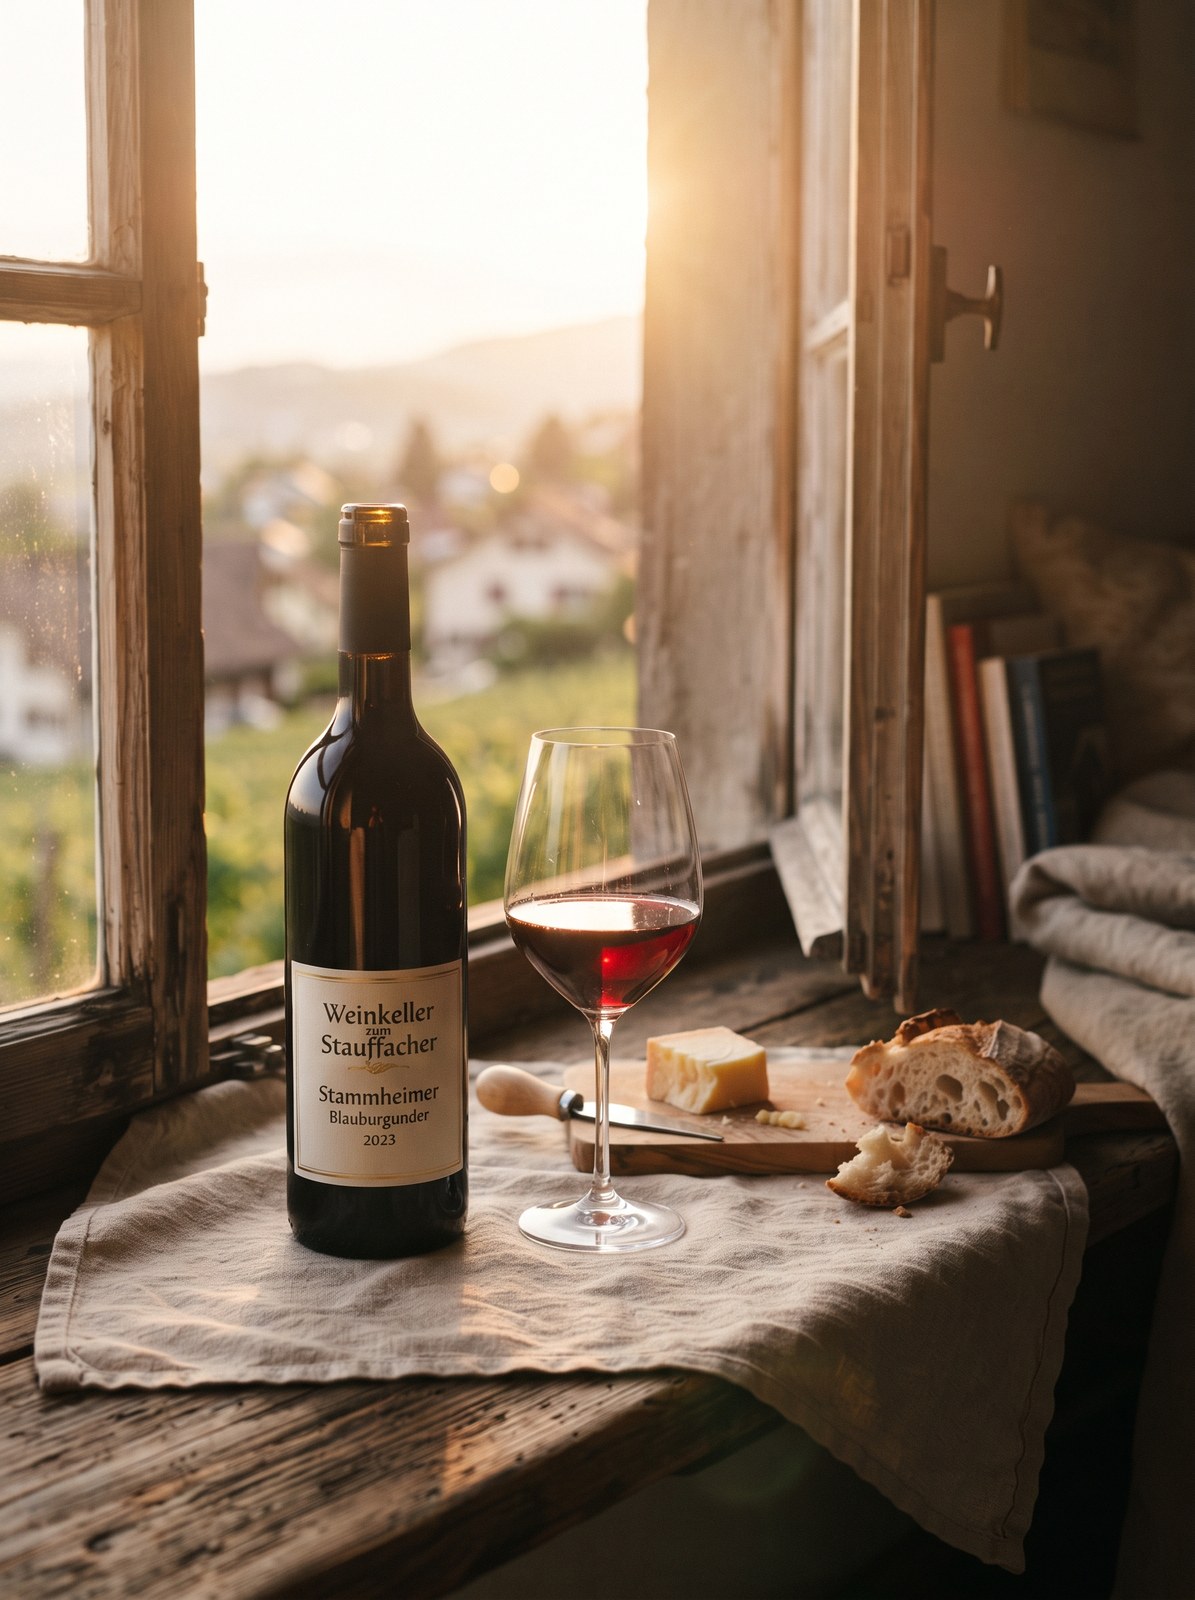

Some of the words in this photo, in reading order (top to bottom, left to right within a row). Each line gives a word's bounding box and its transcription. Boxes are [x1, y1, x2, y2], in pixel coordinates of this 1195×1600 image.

[323, 1002, 434, 1025] Weinkeller
[365, 1027, 391, 1036] zum
[321, 1034, 437, 1060] Stauffacher
[318, 1085, 439, 1105] Stammheimer
[329, 1109, 429, 1129] Blauburgunder
[363, 1134, 396, 1146] 2023
